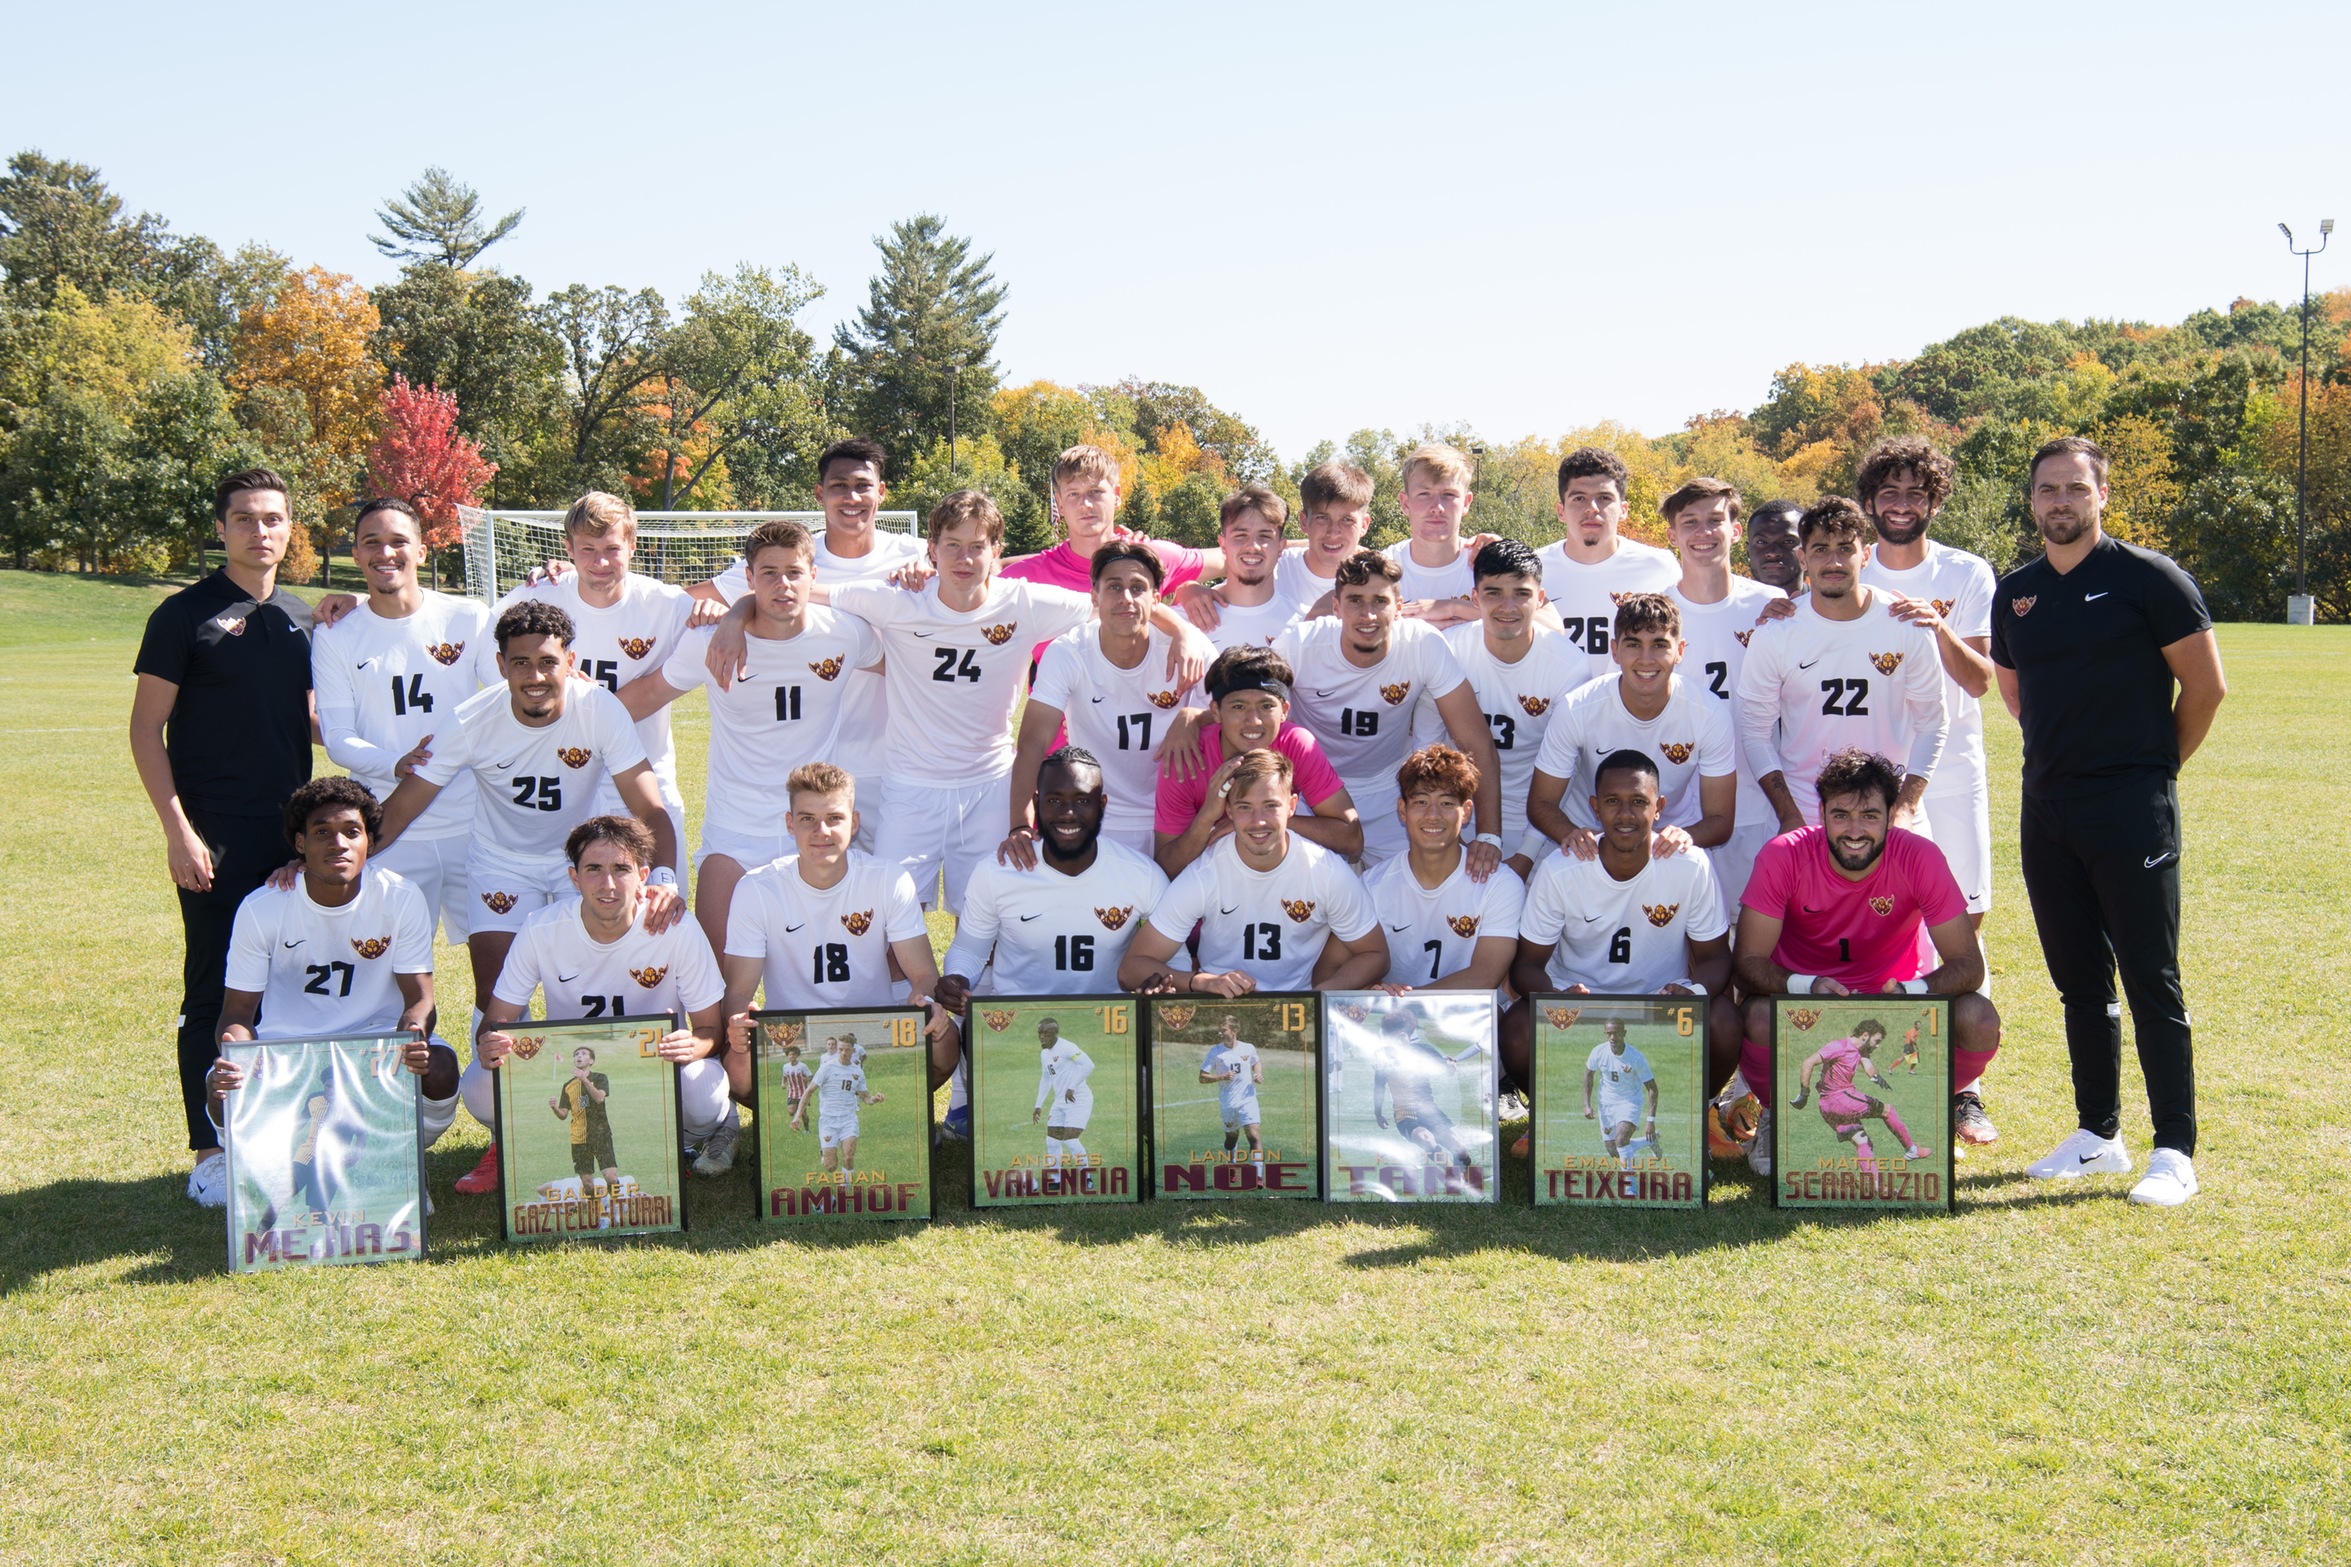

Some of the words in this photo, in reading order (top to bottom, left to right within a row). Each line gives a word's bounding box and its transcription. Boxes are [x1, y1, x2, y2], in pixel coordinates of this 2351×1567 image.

[1564, 617, 1608, 654] 26
[933, 647, 981, 683] 24
[1706, 662, 1730, 700] 2
[392, 674, 433, 715] 14
[775, 686, 801, 722] 11
[1822, 678, 1868, 716] 22
[1118, 713, 1152, 750] 17
[1341, 708, 1378, 737] 19
[512, 776, 561, 811] 25
[1055, 935, 1094, 971] 16
[1244, 923, 1281, 961] 13
[1609, 926, 1631, 965] 6
[1839, 938, 1851, 962] 1
[814, 943, 851, 984] 18
[1424, 939, 1442, 979] 7
[305, 961, 354, 997] 27
[581, 995, 625, 1018] 21
[1095, 1005, 1128, 1034] #16
[1272, 1003, 1306, 1032] #13
[1667, 1007, 1693, 1036] #6
[1920, 1007, 1938, 1036] #1
[882, 1018, 918, 1048] #18
[1009, 1154, 1103, 1167] ANDRES
[1189, 1149, 1281, 1163] LANDON
[1564, 1155, 1674, 1171] EMANUEL
[1818, 1156, 1907, 1171] MATTEO
[546, 1182, 641, 1202] GALDER
[805, 1169, 886, 1185] FABIAN
[983, 1166, 1130, 1199] VALENCIA
[1164, 1162, 1308, 1193] NOE
[1338, 1165, 1485, 1197] TANI
[1543, 1169, 1693, 1203] TEIXEIRA
[1785, 1171, 1941, 1202] SCARDUZIO
[513, 1195, 673, 1236] GAZTELU-ITURRI
[769, 1182, 922, 1218] AMHOF
[293, 1209, 366, 1228] KEVIN
[244, 1221, 411, 1264] MEJIAS
